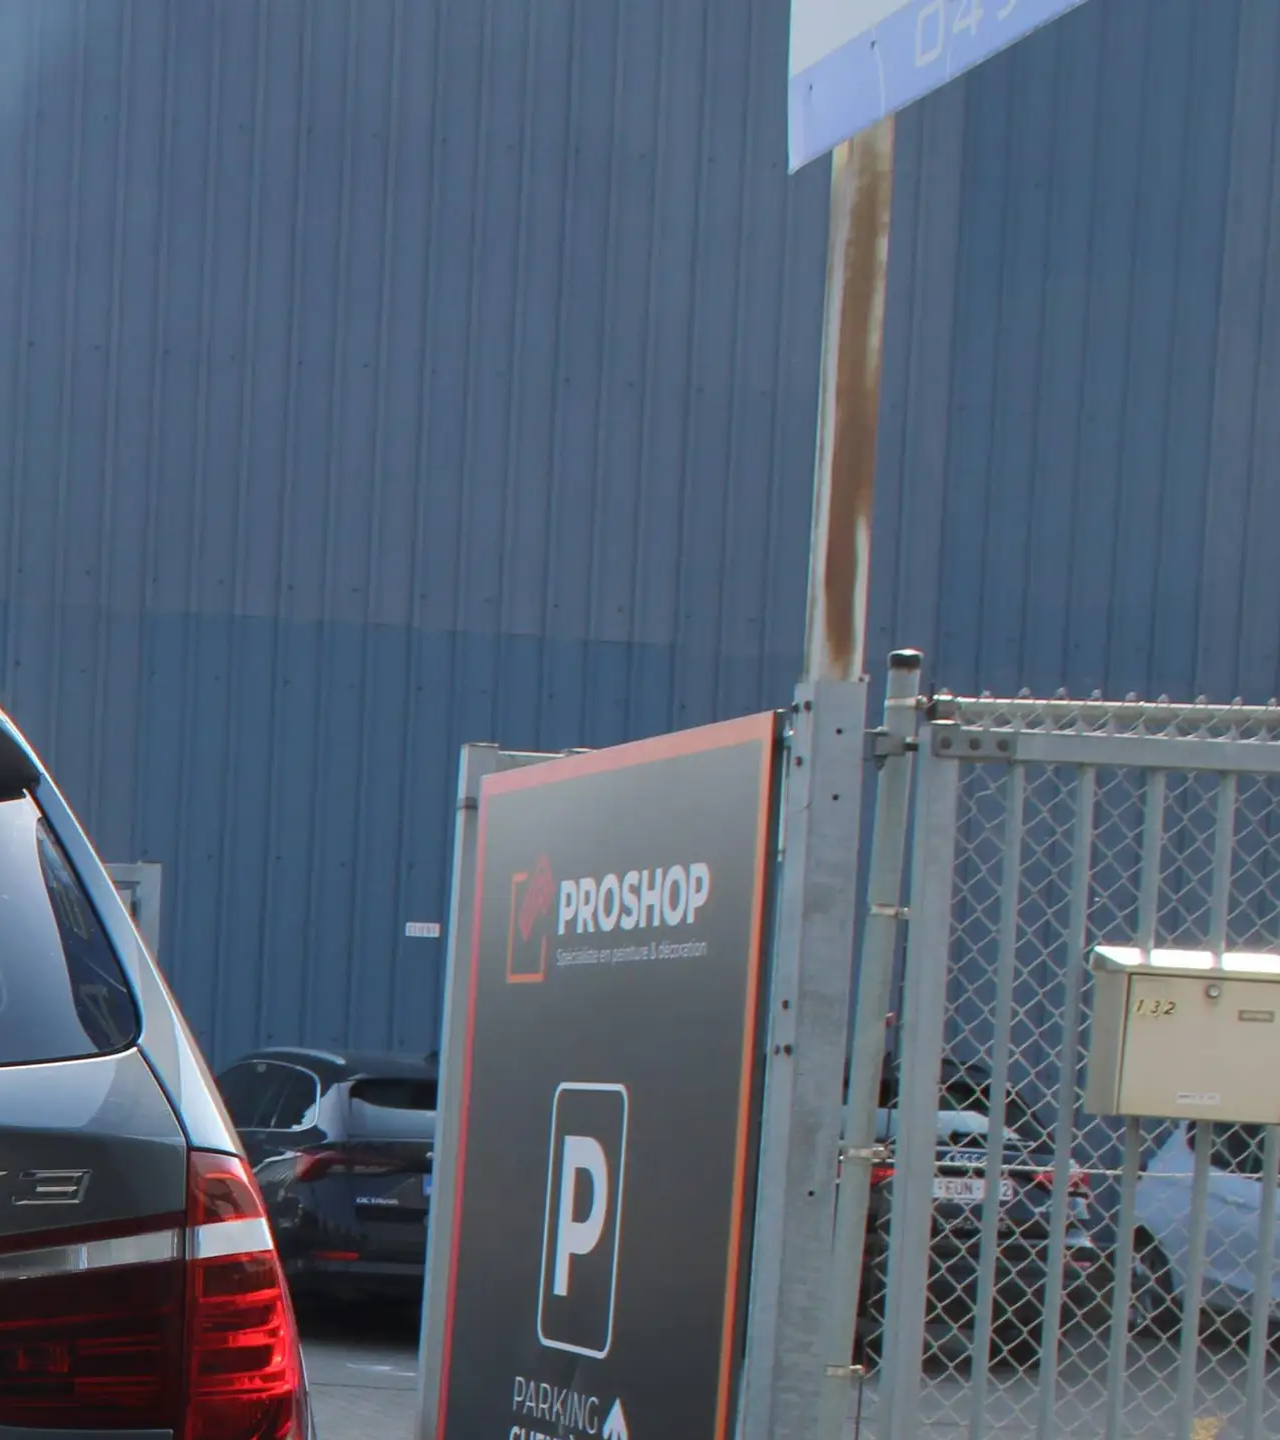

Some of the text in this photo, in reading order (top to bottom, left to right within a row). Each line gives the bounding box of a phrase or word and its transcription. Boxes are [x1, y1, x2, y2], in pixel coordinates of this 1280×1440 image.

[557, 862, 710, 936] PROSHOP
[599, 949, 611, 963] en
[650, 940, 657, 960] &
[1135, 999, 1176, 1016] 132
[553, 1135, 609, 1297] P
[512, 1376, 599, 1434] PARKING
